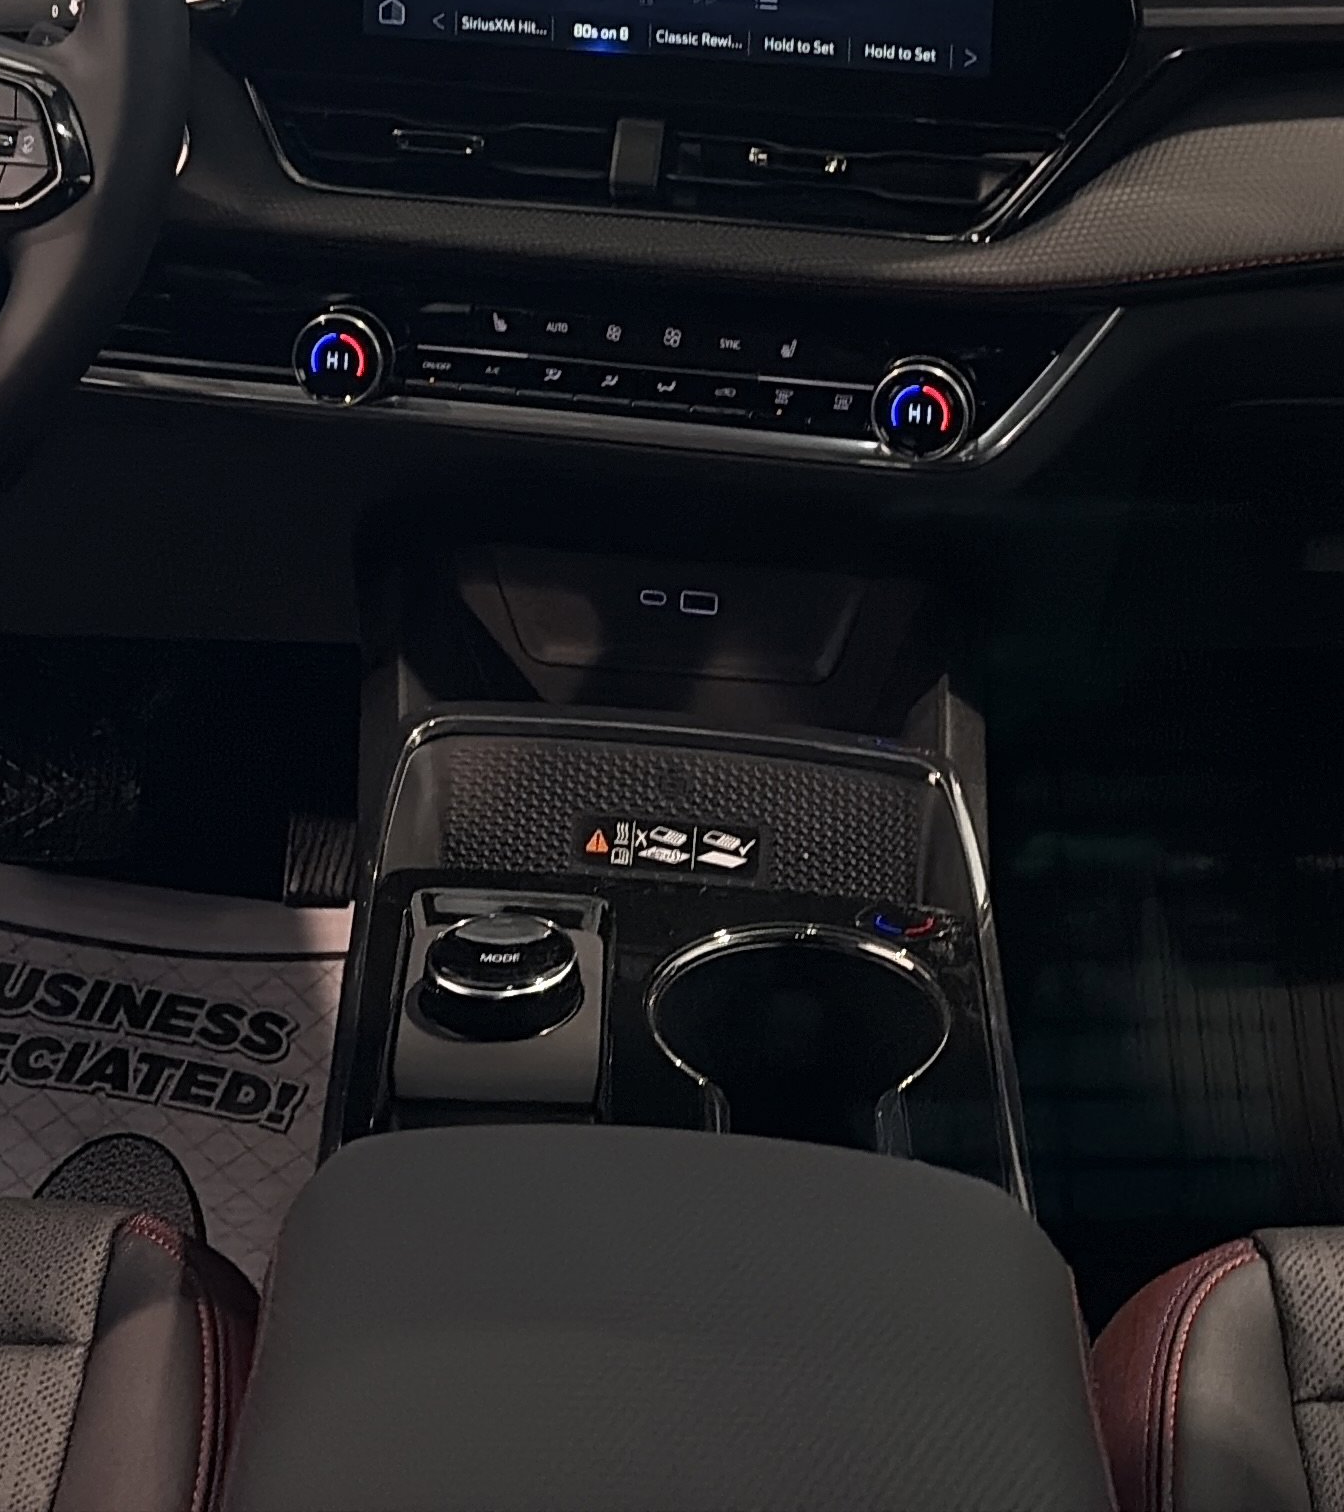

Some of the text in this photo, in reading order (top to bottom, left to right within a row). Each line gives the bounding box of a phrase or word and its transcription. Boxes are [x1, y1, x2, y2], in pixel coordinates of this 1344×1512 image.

[461, 15, 516, 34] SiriusXM
[573, 23, 630, 42] 80s on 8
[656, 29, 699, 47] Classic
[764, 37, 836, 56] Hold to Set
[864, 43, 937, 64] Hold to Set
[545, 322, 568, 335] AUTO
[719, 337, 742, 351] SYNC
